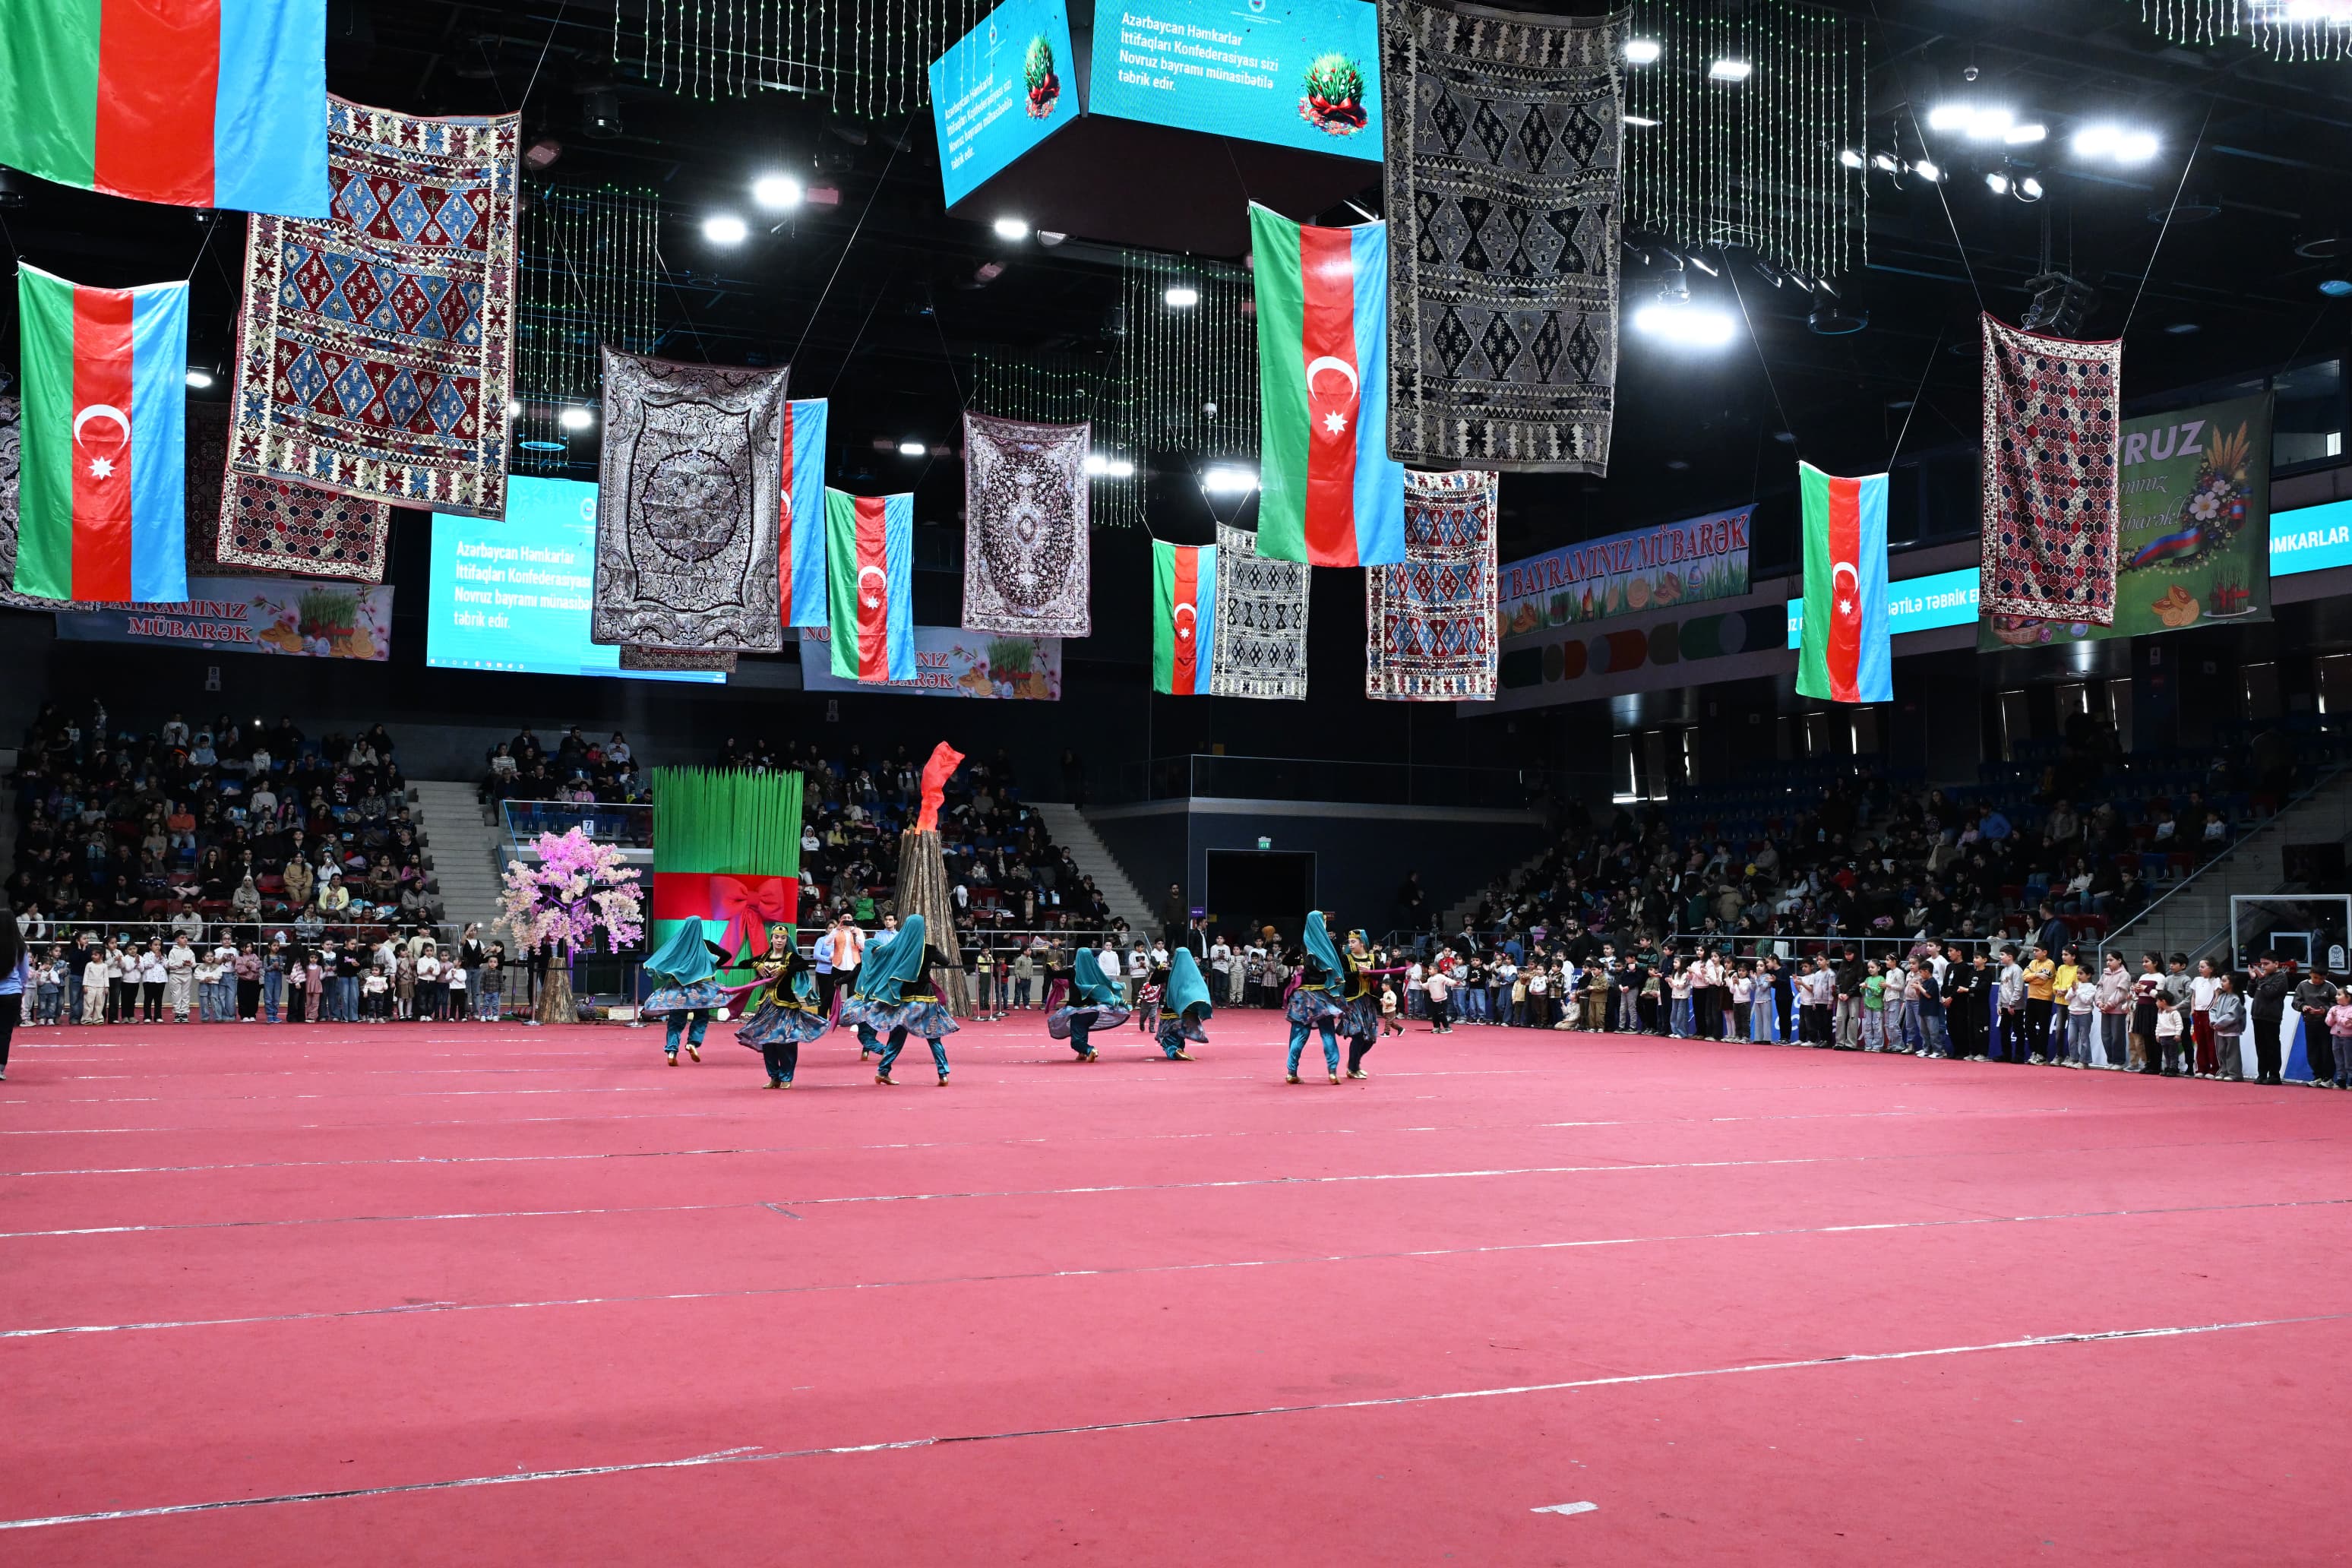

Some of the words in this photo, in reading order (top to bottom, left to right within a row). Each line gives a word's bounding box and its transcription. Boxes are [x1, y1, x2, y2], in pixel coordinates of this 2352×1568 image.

[1121, 12, 1184, 35] Azərbaycan
[1187, 24, 1243, 46] Həmkarlar
[1121, 28, 1171, 52] İttifaqları
[1174, 41, 1258, 68] Konfederasiyası
[1260, 57, 1279, 71] sizi
[1118, 69, 1150, 87] təbrik
[1153, 75, 1176, 90] edir.
[1119, 49, 1158, 68] Novruz
[1161, 56, 1204, 76] bayramı
[1206, 68, 1274, 89] münasibətilə
[2118, 420, 2206, 466] RUZ
[457, 540, 518, 563] Azərbaycan
[520, 546, 576, 565] Həmkarlar
[2269, 526, 2350, 554] MKARLAR
[1510, 539, 1633, 599] BAYRAMINIZ
[1637, 514, 1749, 568] MÜBARƏK
[456, 560, 505, 584] İttifaqları
[508, 567, 591, 590] Konfederasiyası
[454, 586, 492, 603] Novruz
[495, 589, 537, 609] bayramı
[540, 592, 593, 611] münasibə
[1925, 588, 1967, 611] TƏBRİK
[128, 615, 253, 643] MÜBARƏK
[454, 611, 485, 627] təbrik
[488, 612, 511, 629] edir.
